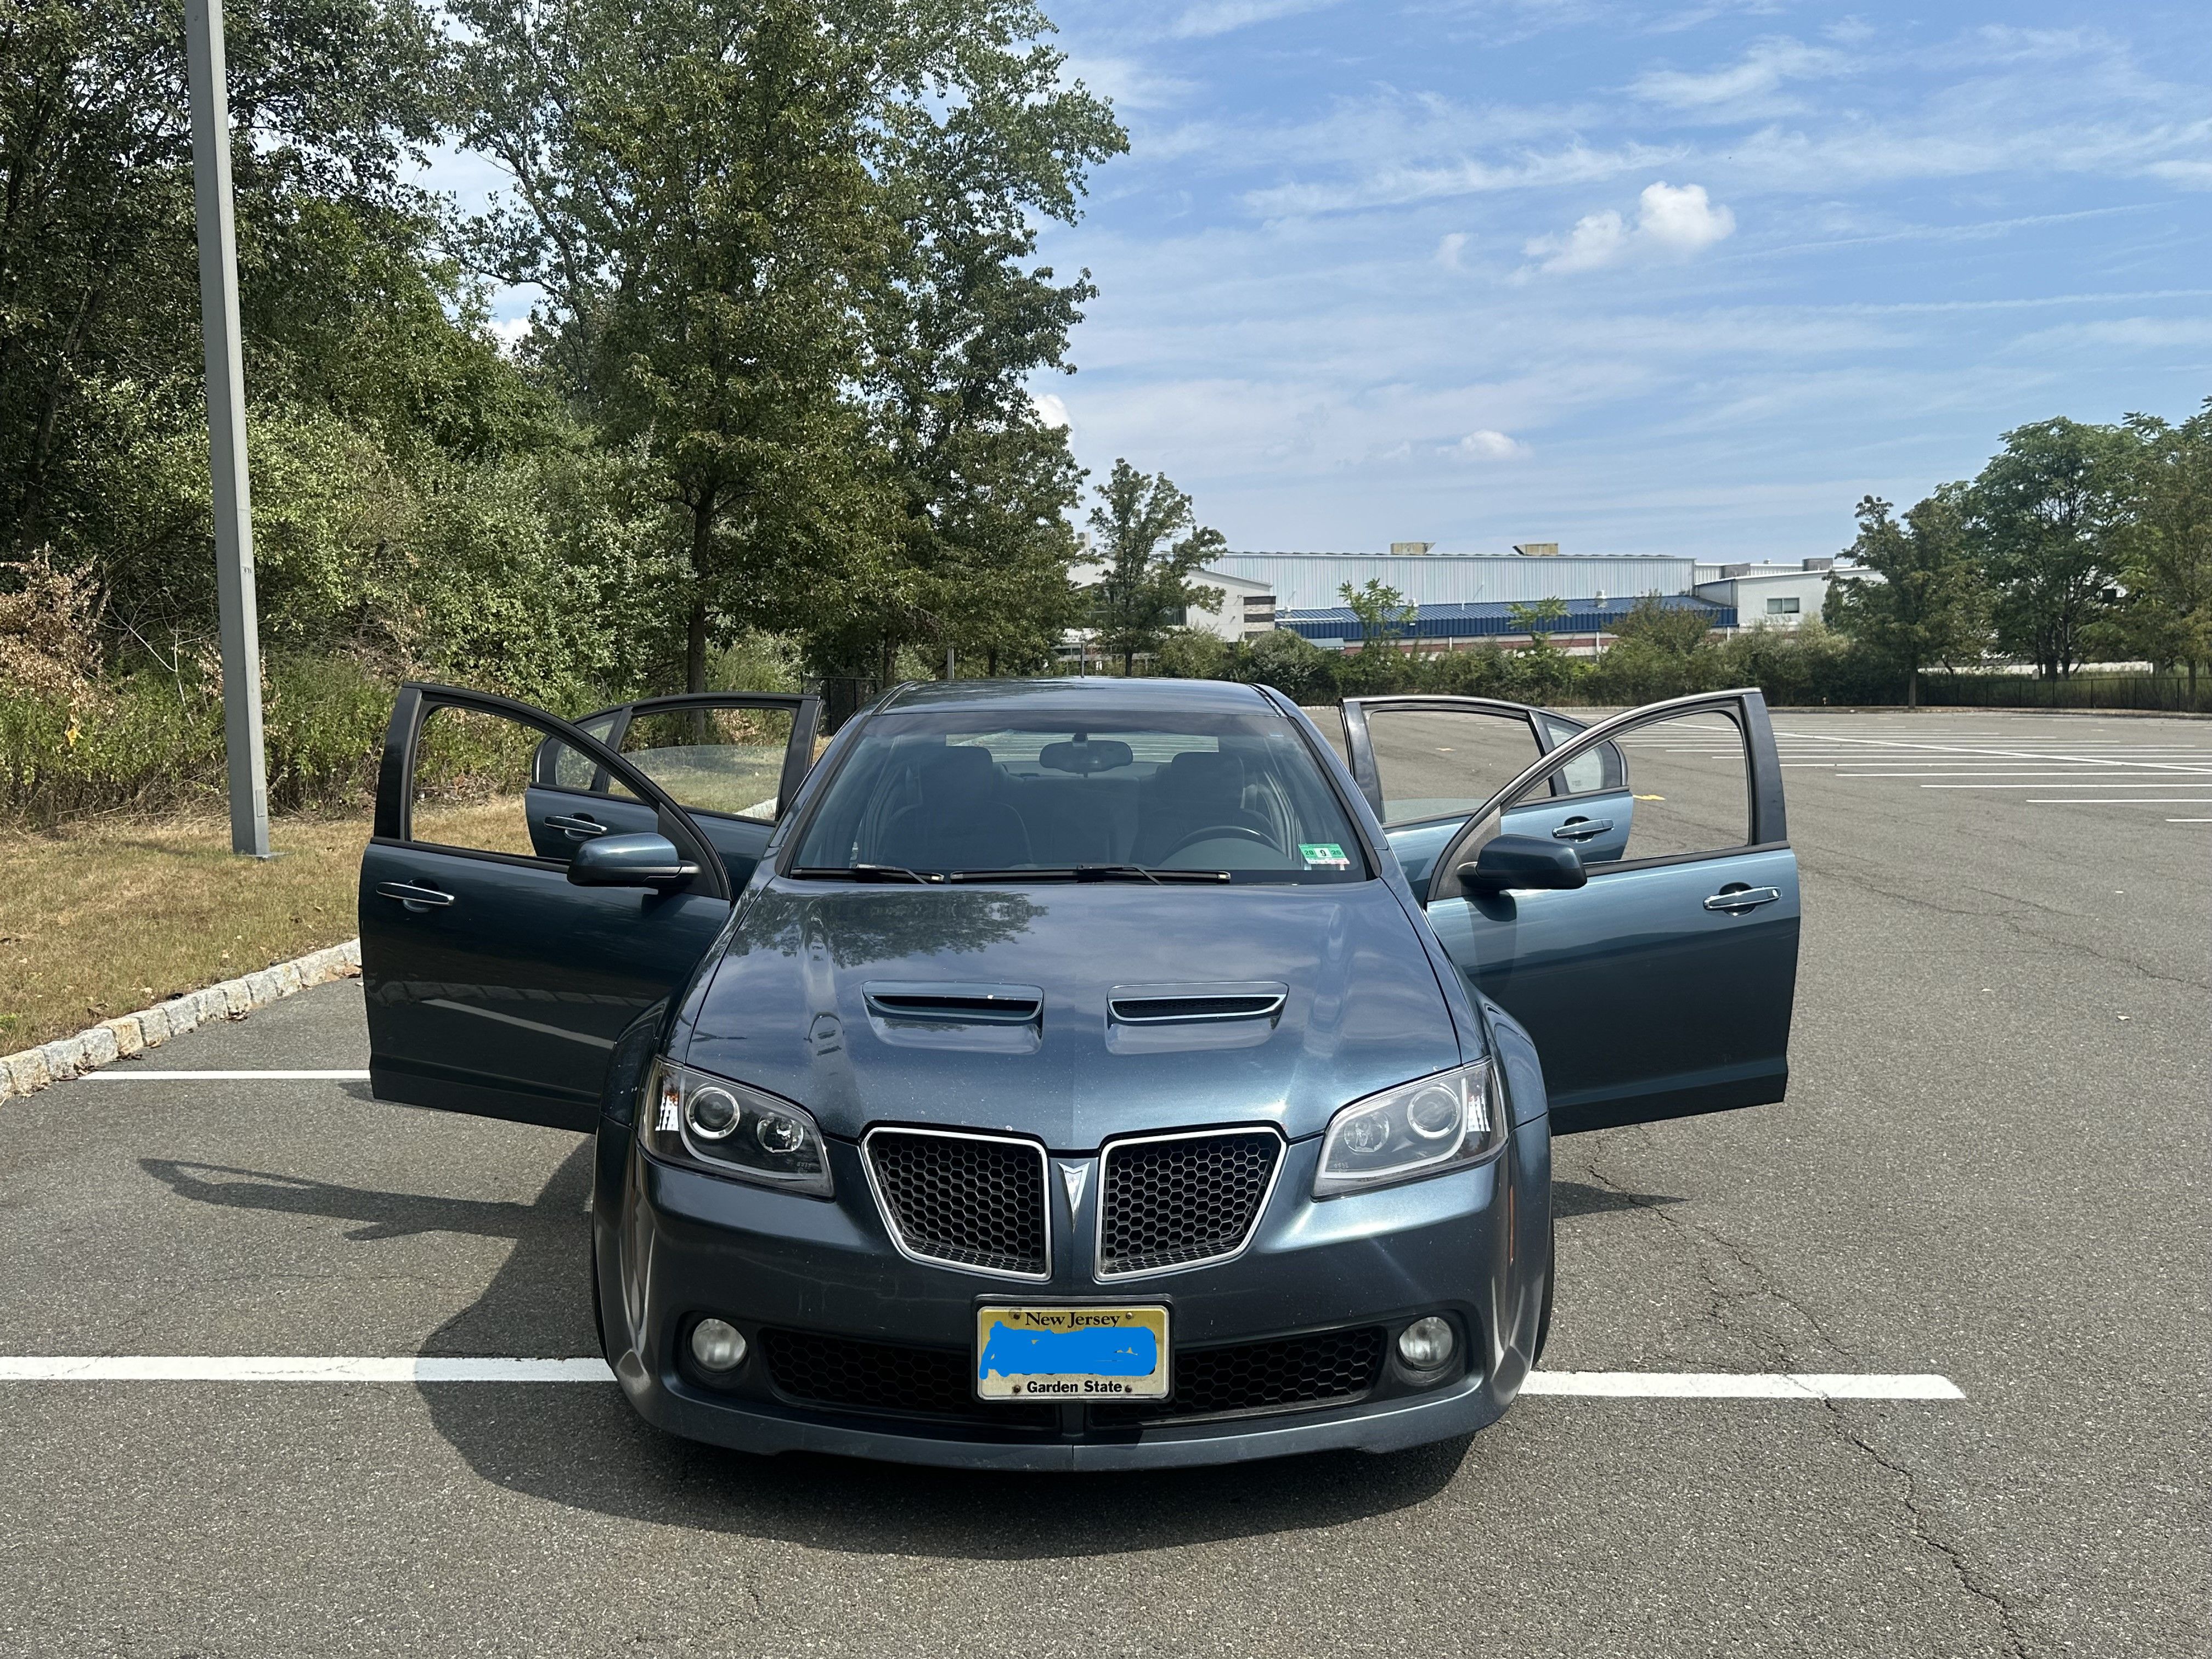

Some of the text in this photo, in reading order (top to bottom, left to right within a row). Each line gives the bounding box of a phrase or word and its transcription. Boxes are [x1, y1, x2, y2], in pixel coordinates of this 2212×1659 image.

[1025, 1312, 1120, 1328] New Jersey
[1027, 1381, 1122, 1393] Garden State
